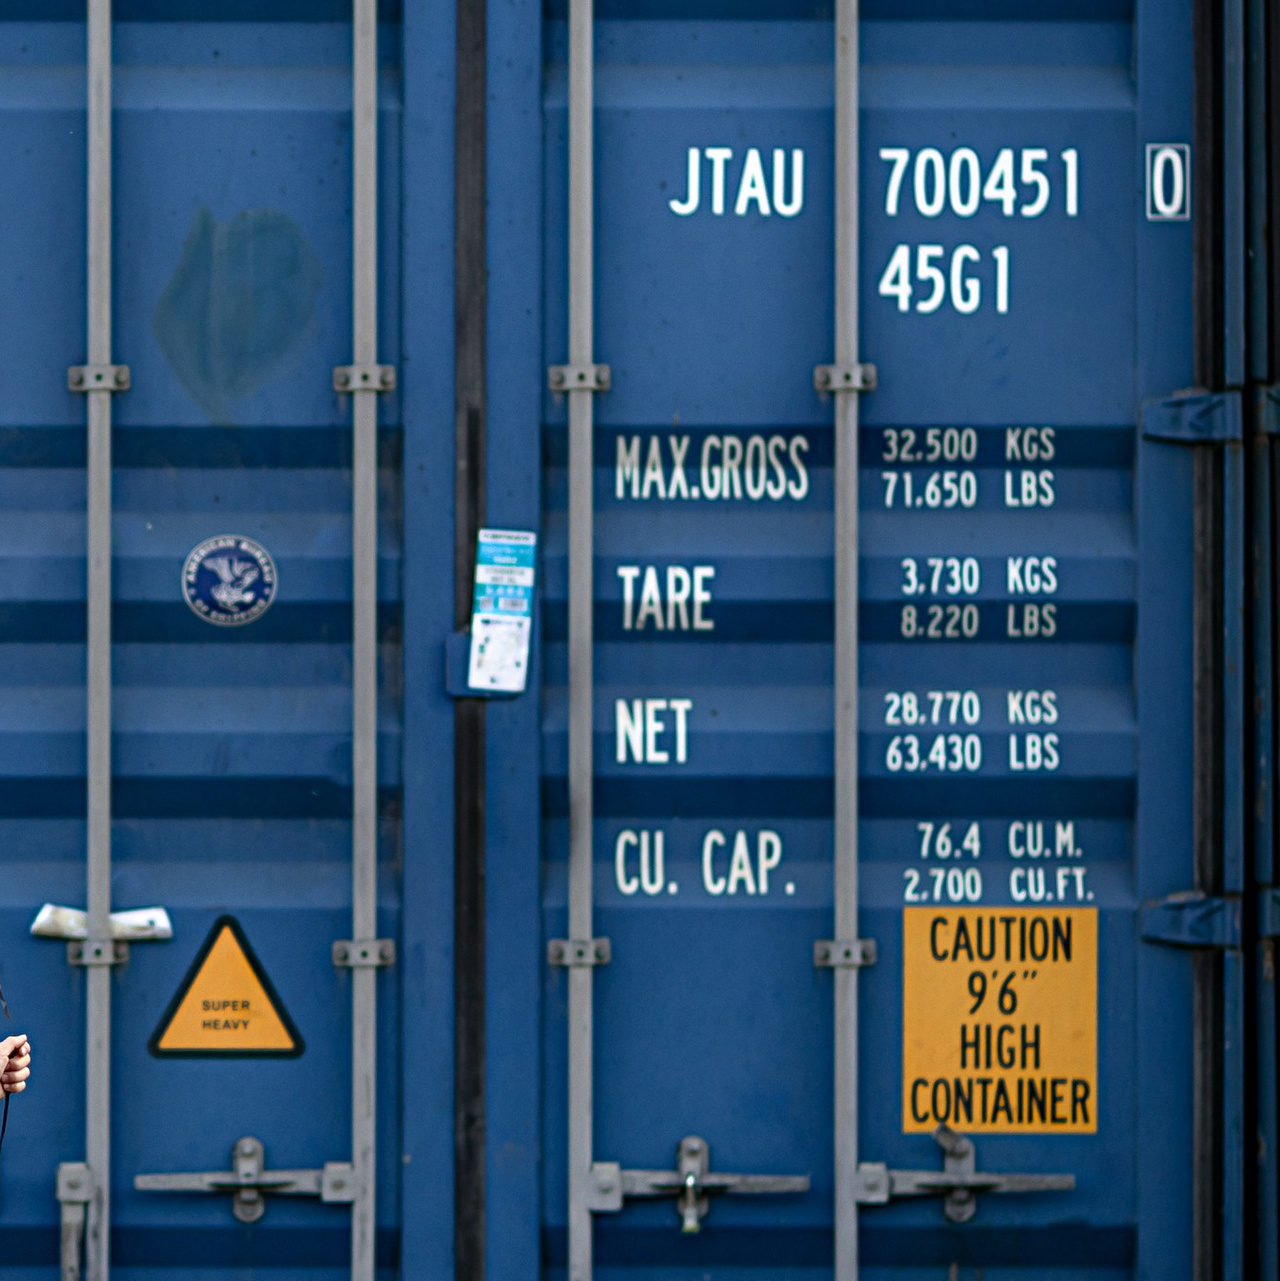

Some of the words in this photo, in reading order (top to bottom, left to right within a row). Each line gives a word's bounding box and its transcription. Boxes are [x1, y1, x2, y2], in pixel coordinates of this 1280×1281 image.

[669, 147, 804, 216] JTAU
[879, 147, 1078, 217] 700451
[879, 244, 1010, 314] 45G1
[882, 428, 978, 461] 32.500
[1006, 428, 1056, 460] KGS
[615, 435, 809, 500] MAX.GROSS
[882, 471, 978, 508] 71.650
[1004, 470, 1055, 507] LBS
[901, 557, 980, 595] 3.730
[1007, 557, 1058, 594] KGS
[617, 566, 715, 630] TARE
[901, 604, 980, 638] 8.220
[1007, 604, 1057, 637] LBS
[884, 691, 981, 726] 28.770
[1007, 691, 1058, 724] KGS
[616, 699, 693, 764] NET
[886, 734, 983, 771] 63.430
[1009, 734, 1060, 770] LBS
[918, 822, 981, 858] 76.4
[1008, 821, 1083, 858] CU.M.
[616, 830, 678, 895] CU.
[702, 830, 796, 895] CAP.
[903, 868, 983, 902] 2.700
[1009, 868, 1095, 902] CU.FT.
[930, 916, 1073, 963] CAUTION
[202, 1000, 251, 1011] SUPER
[202, 1019, 251, 1030] HEAVY
[960, 1023, 1041, 1070] HIGH
[911, 1078, 1090, 1124] CONTAINER
